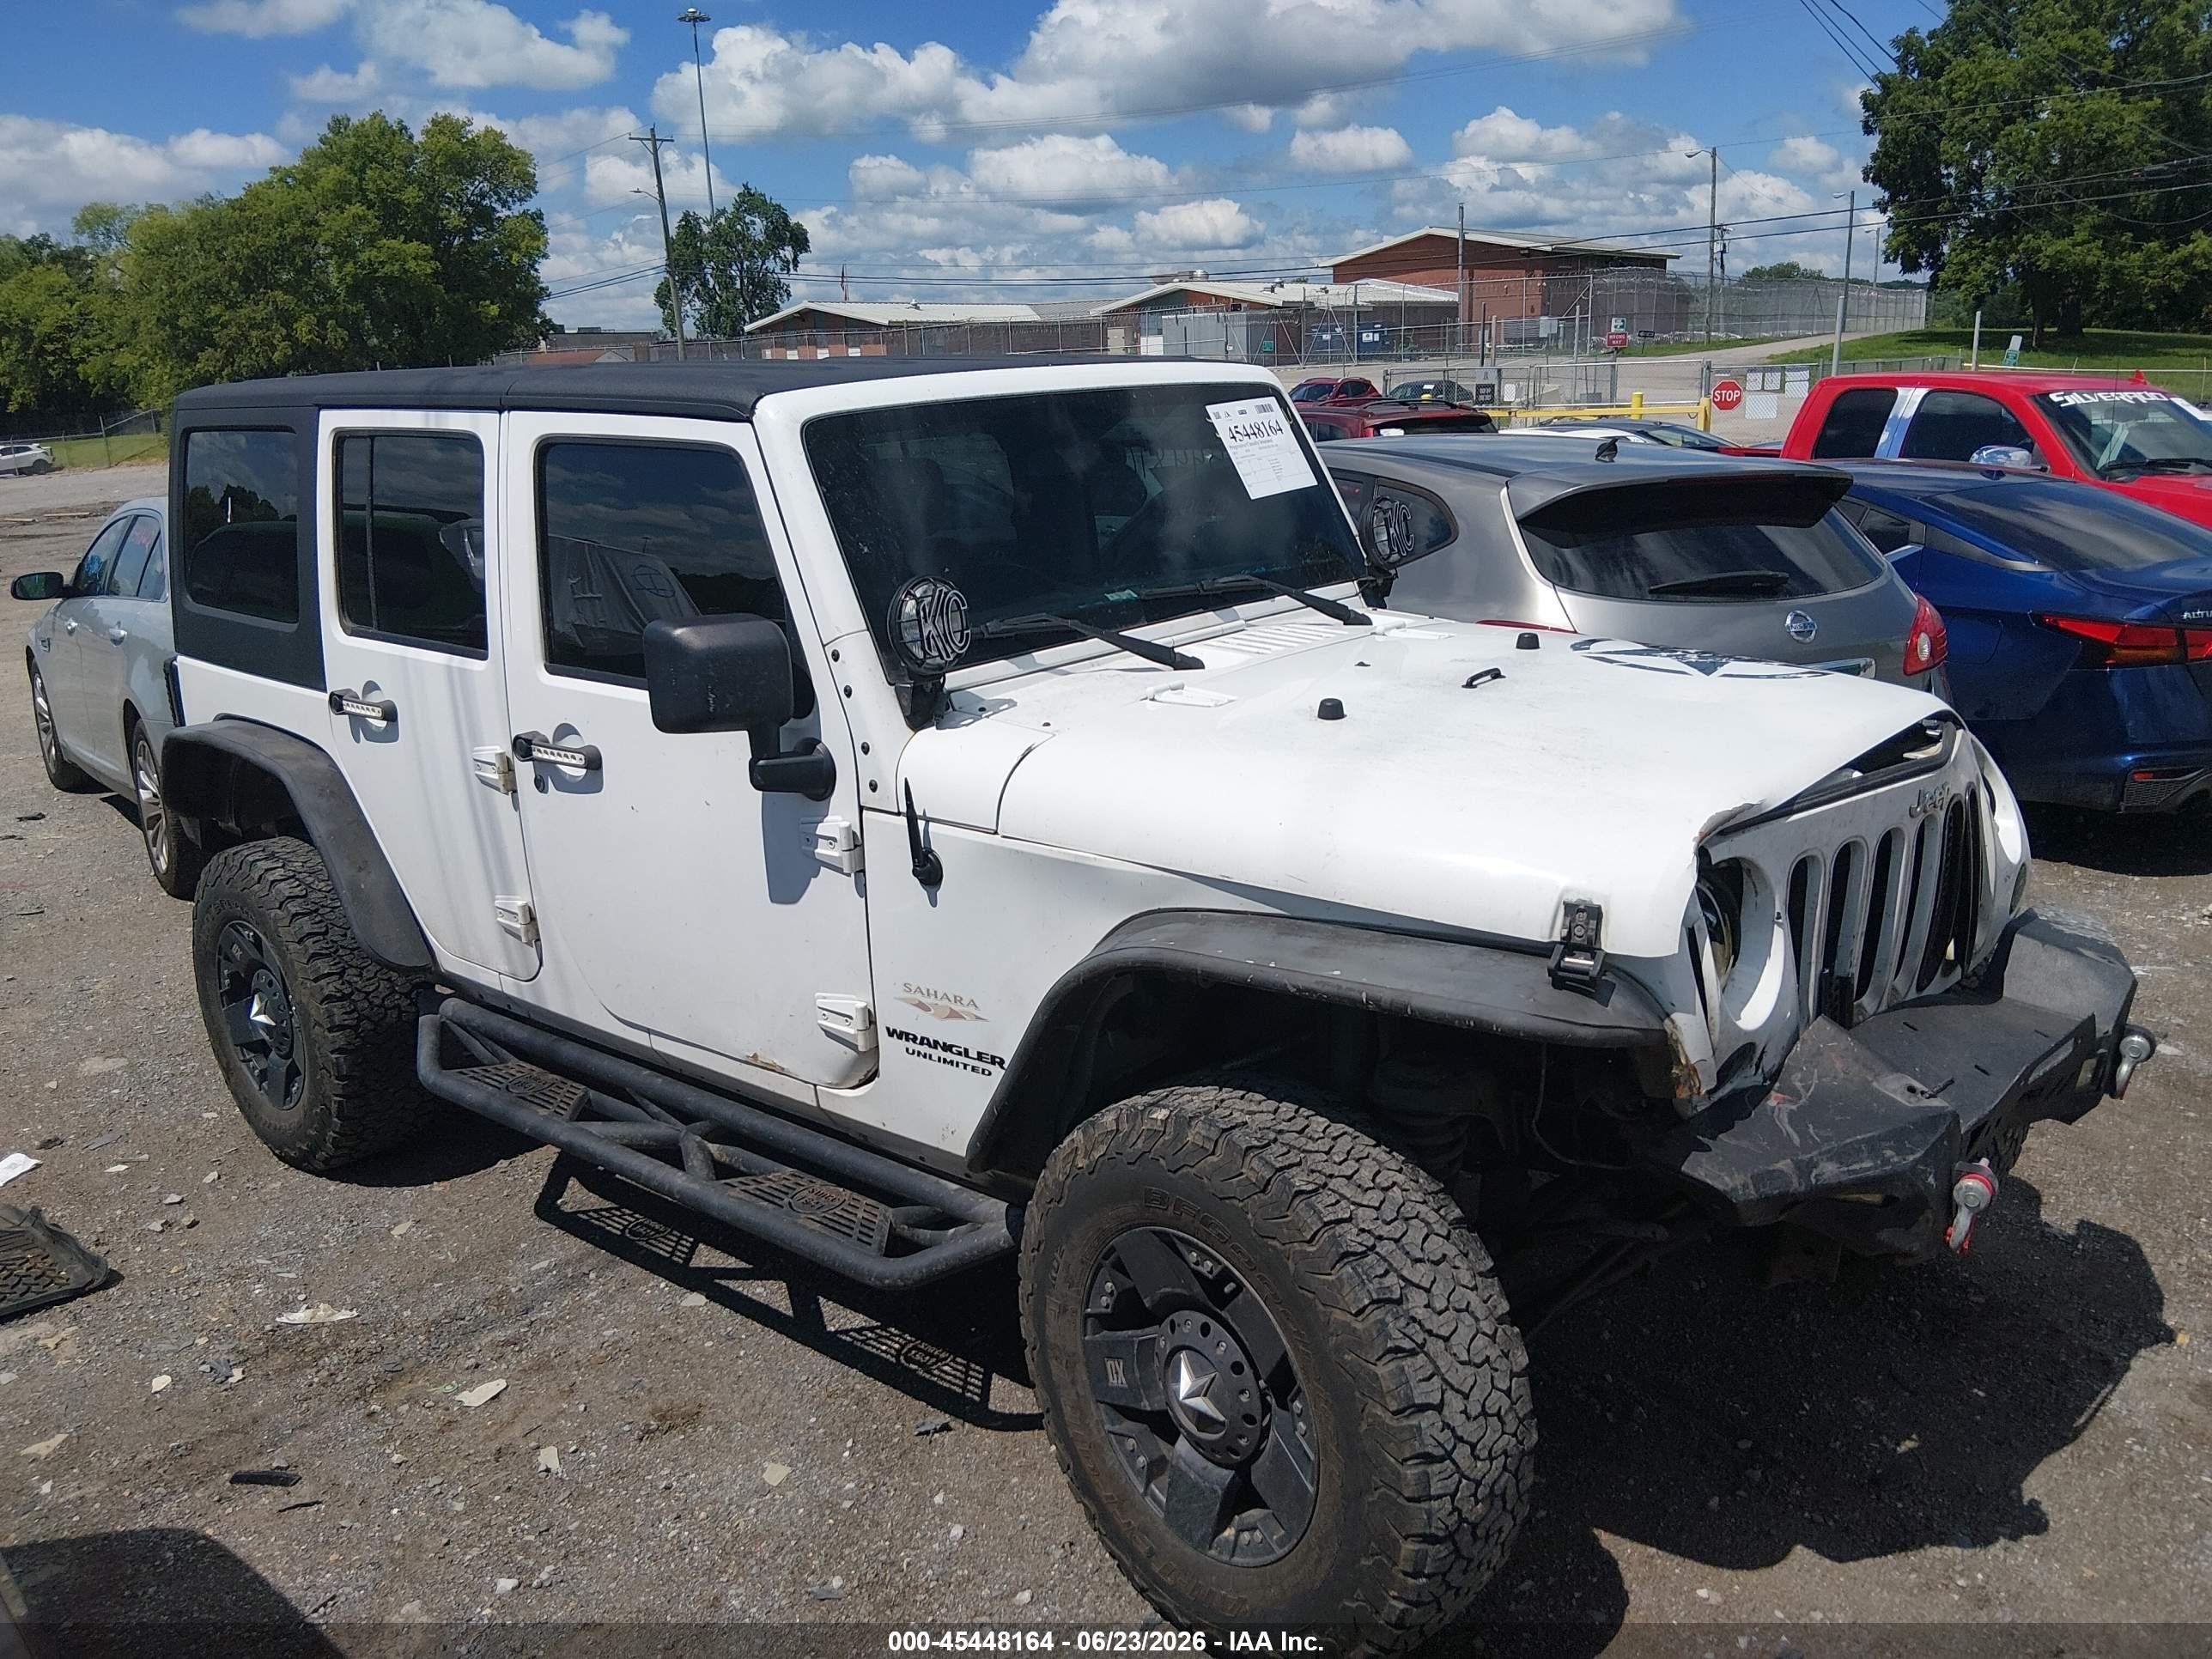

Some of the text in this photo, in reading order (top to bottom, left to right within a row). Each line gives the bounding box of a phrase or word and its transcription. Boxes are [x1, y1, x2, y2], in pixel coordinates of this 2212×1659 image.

[1714, 390, 1741, 402] STOP
[1228, 418, 1284, 443] 45448164
[1387, 501, 1415, 556] KC
[920, 586, 972, 662] KC
[902, 982, 981, 1011] SAHARA
[885, 1026, 1006, 1071] WRANGLER
[905, 1047, 993, 1077] UNLIMITED
